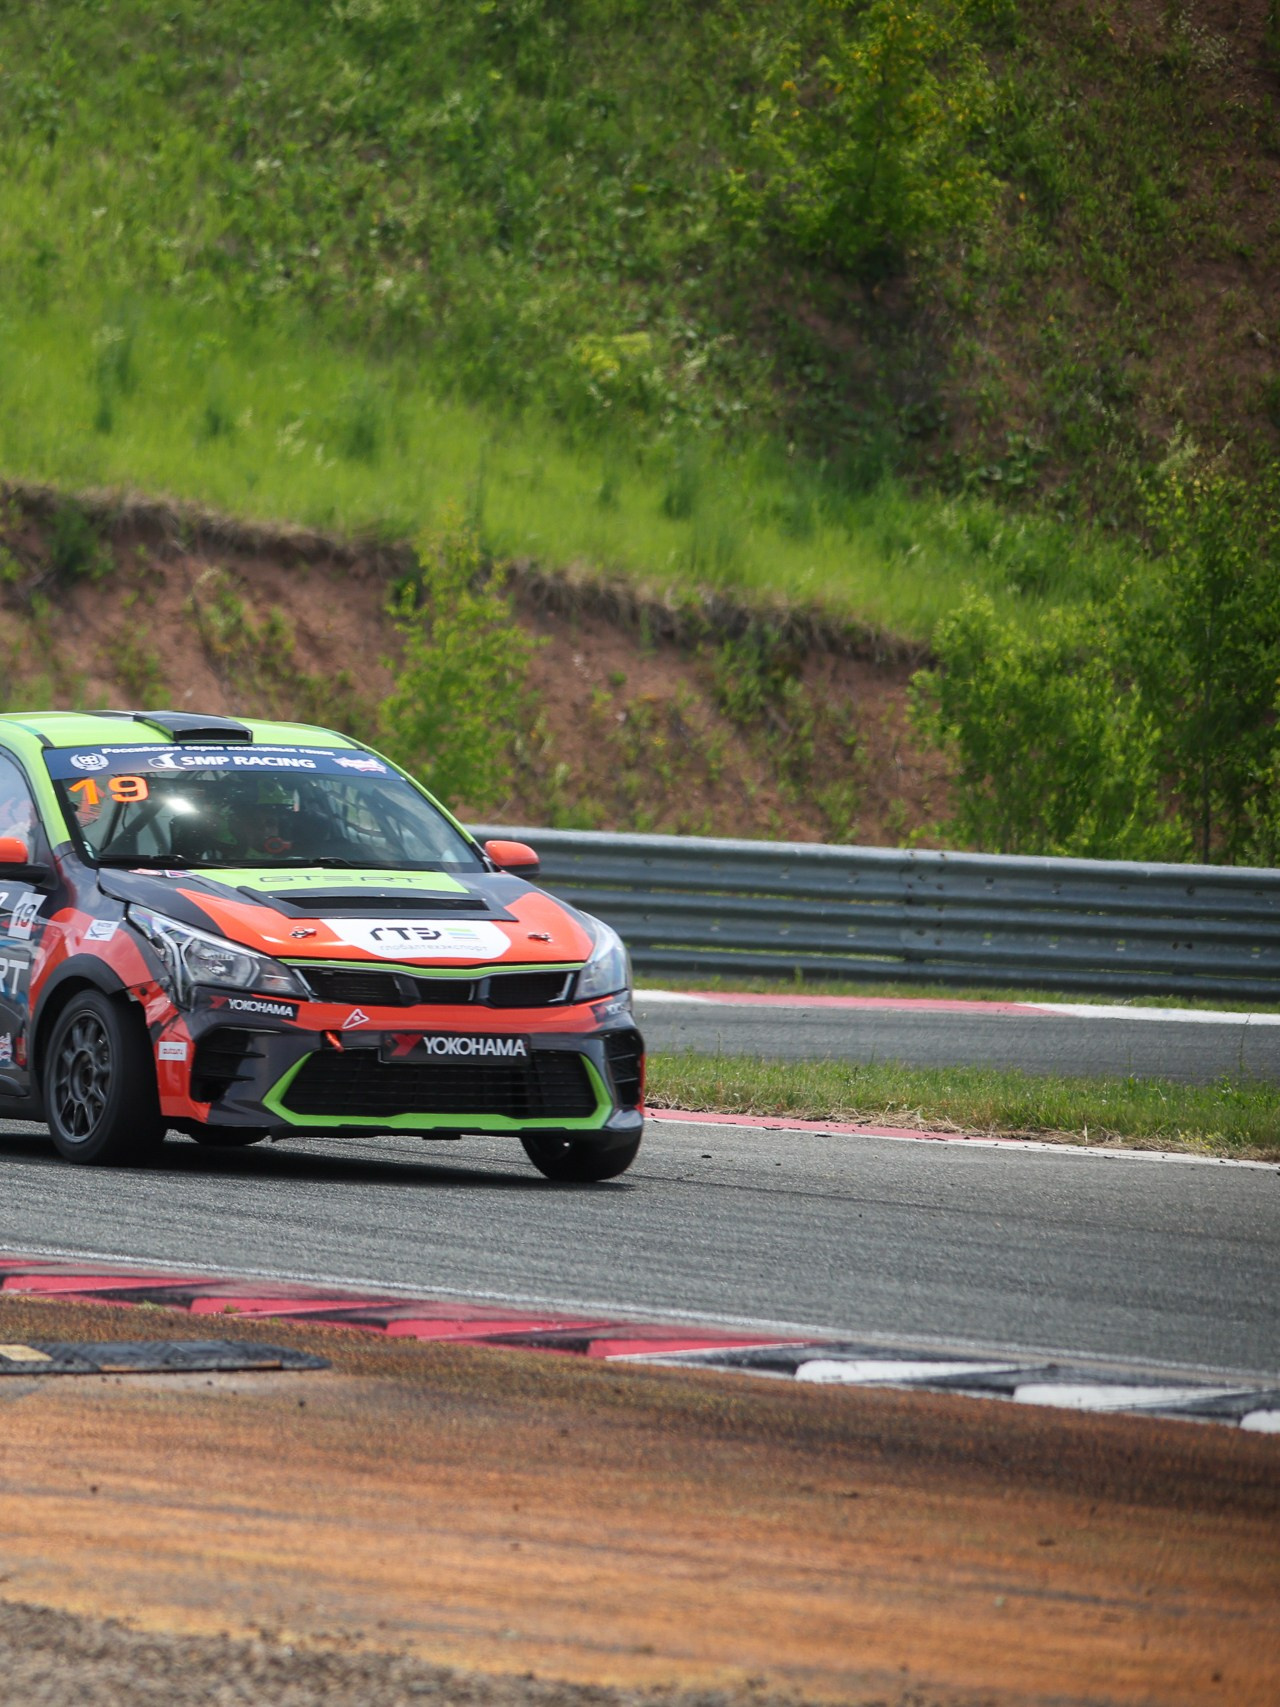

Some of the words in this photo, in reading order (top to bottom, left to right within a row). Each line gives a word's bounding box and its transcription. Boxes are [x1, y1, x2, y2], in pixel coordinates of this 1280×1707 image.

[101, 745, 182, 754] Российская
[226, 746, 298, 754] кольцевых
[298, 748, 336, 757] гонок
[180, 756, 230, 766] SMP
[232, 756, 317, 769] RACING
[68, 775, 149, 804] 19
[12, 904, 37, 928] 19
[228, 999, 294, 1017] YOKOHAMA
[423, 1036, 528, 1057] YOKOHAMA
